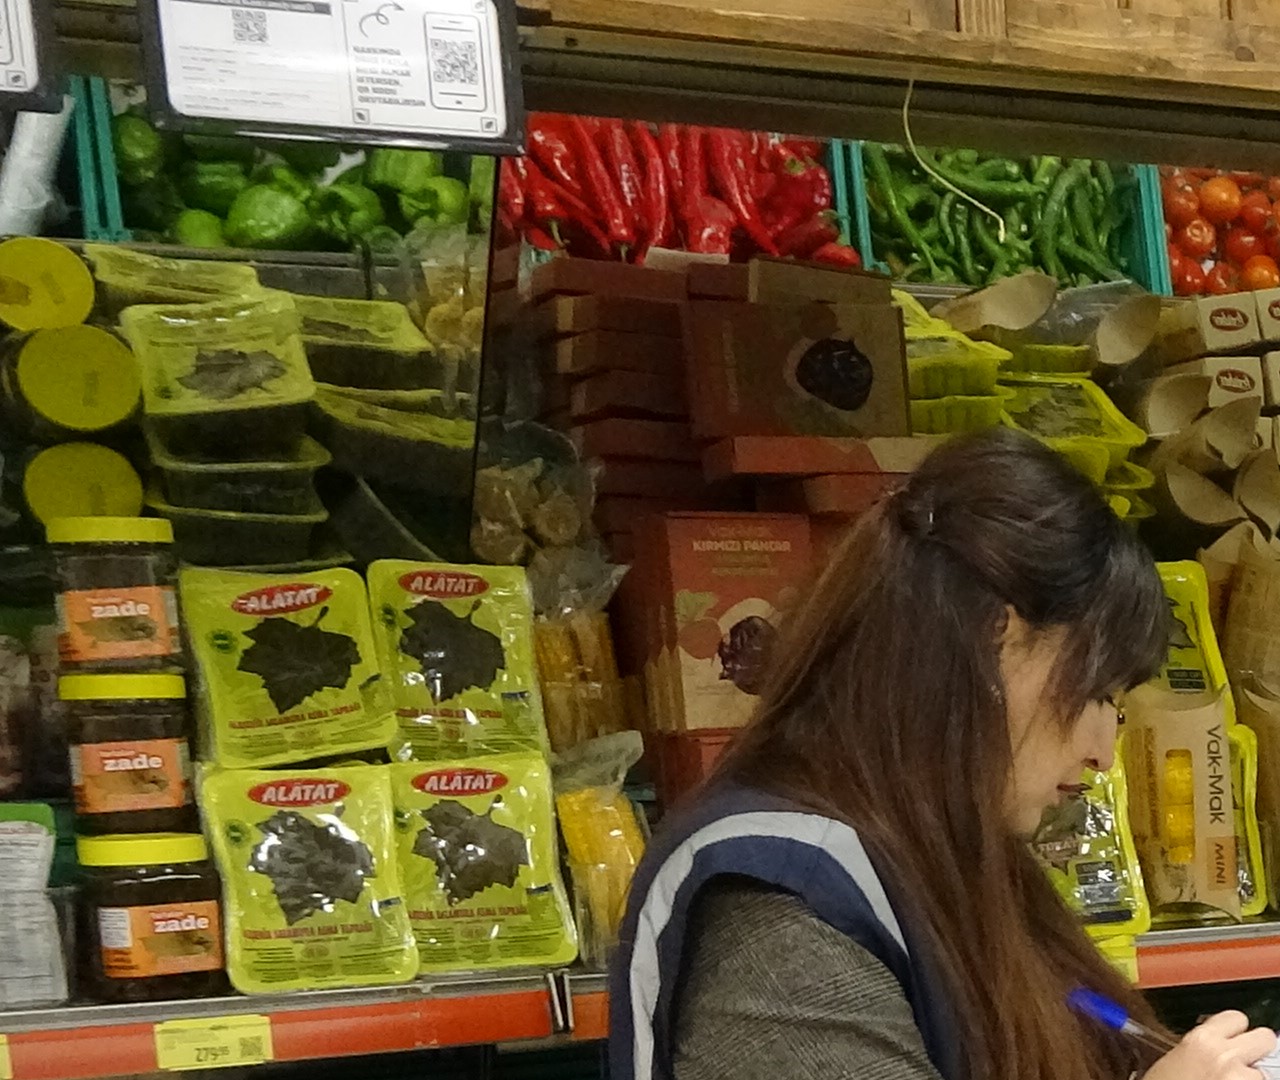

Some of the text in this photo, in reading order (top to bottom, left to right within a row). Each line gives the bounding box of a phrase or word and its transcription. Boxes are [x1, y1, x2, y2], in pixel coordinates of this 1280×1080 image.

[91, 601, 150, 618] zade
[102, 754, 163, 771] zade
[1206, 724, 1225, 824] Vak-Mak
[1214, 843, 1226, 884] MINI
[153, 915, 209, 934] zade
